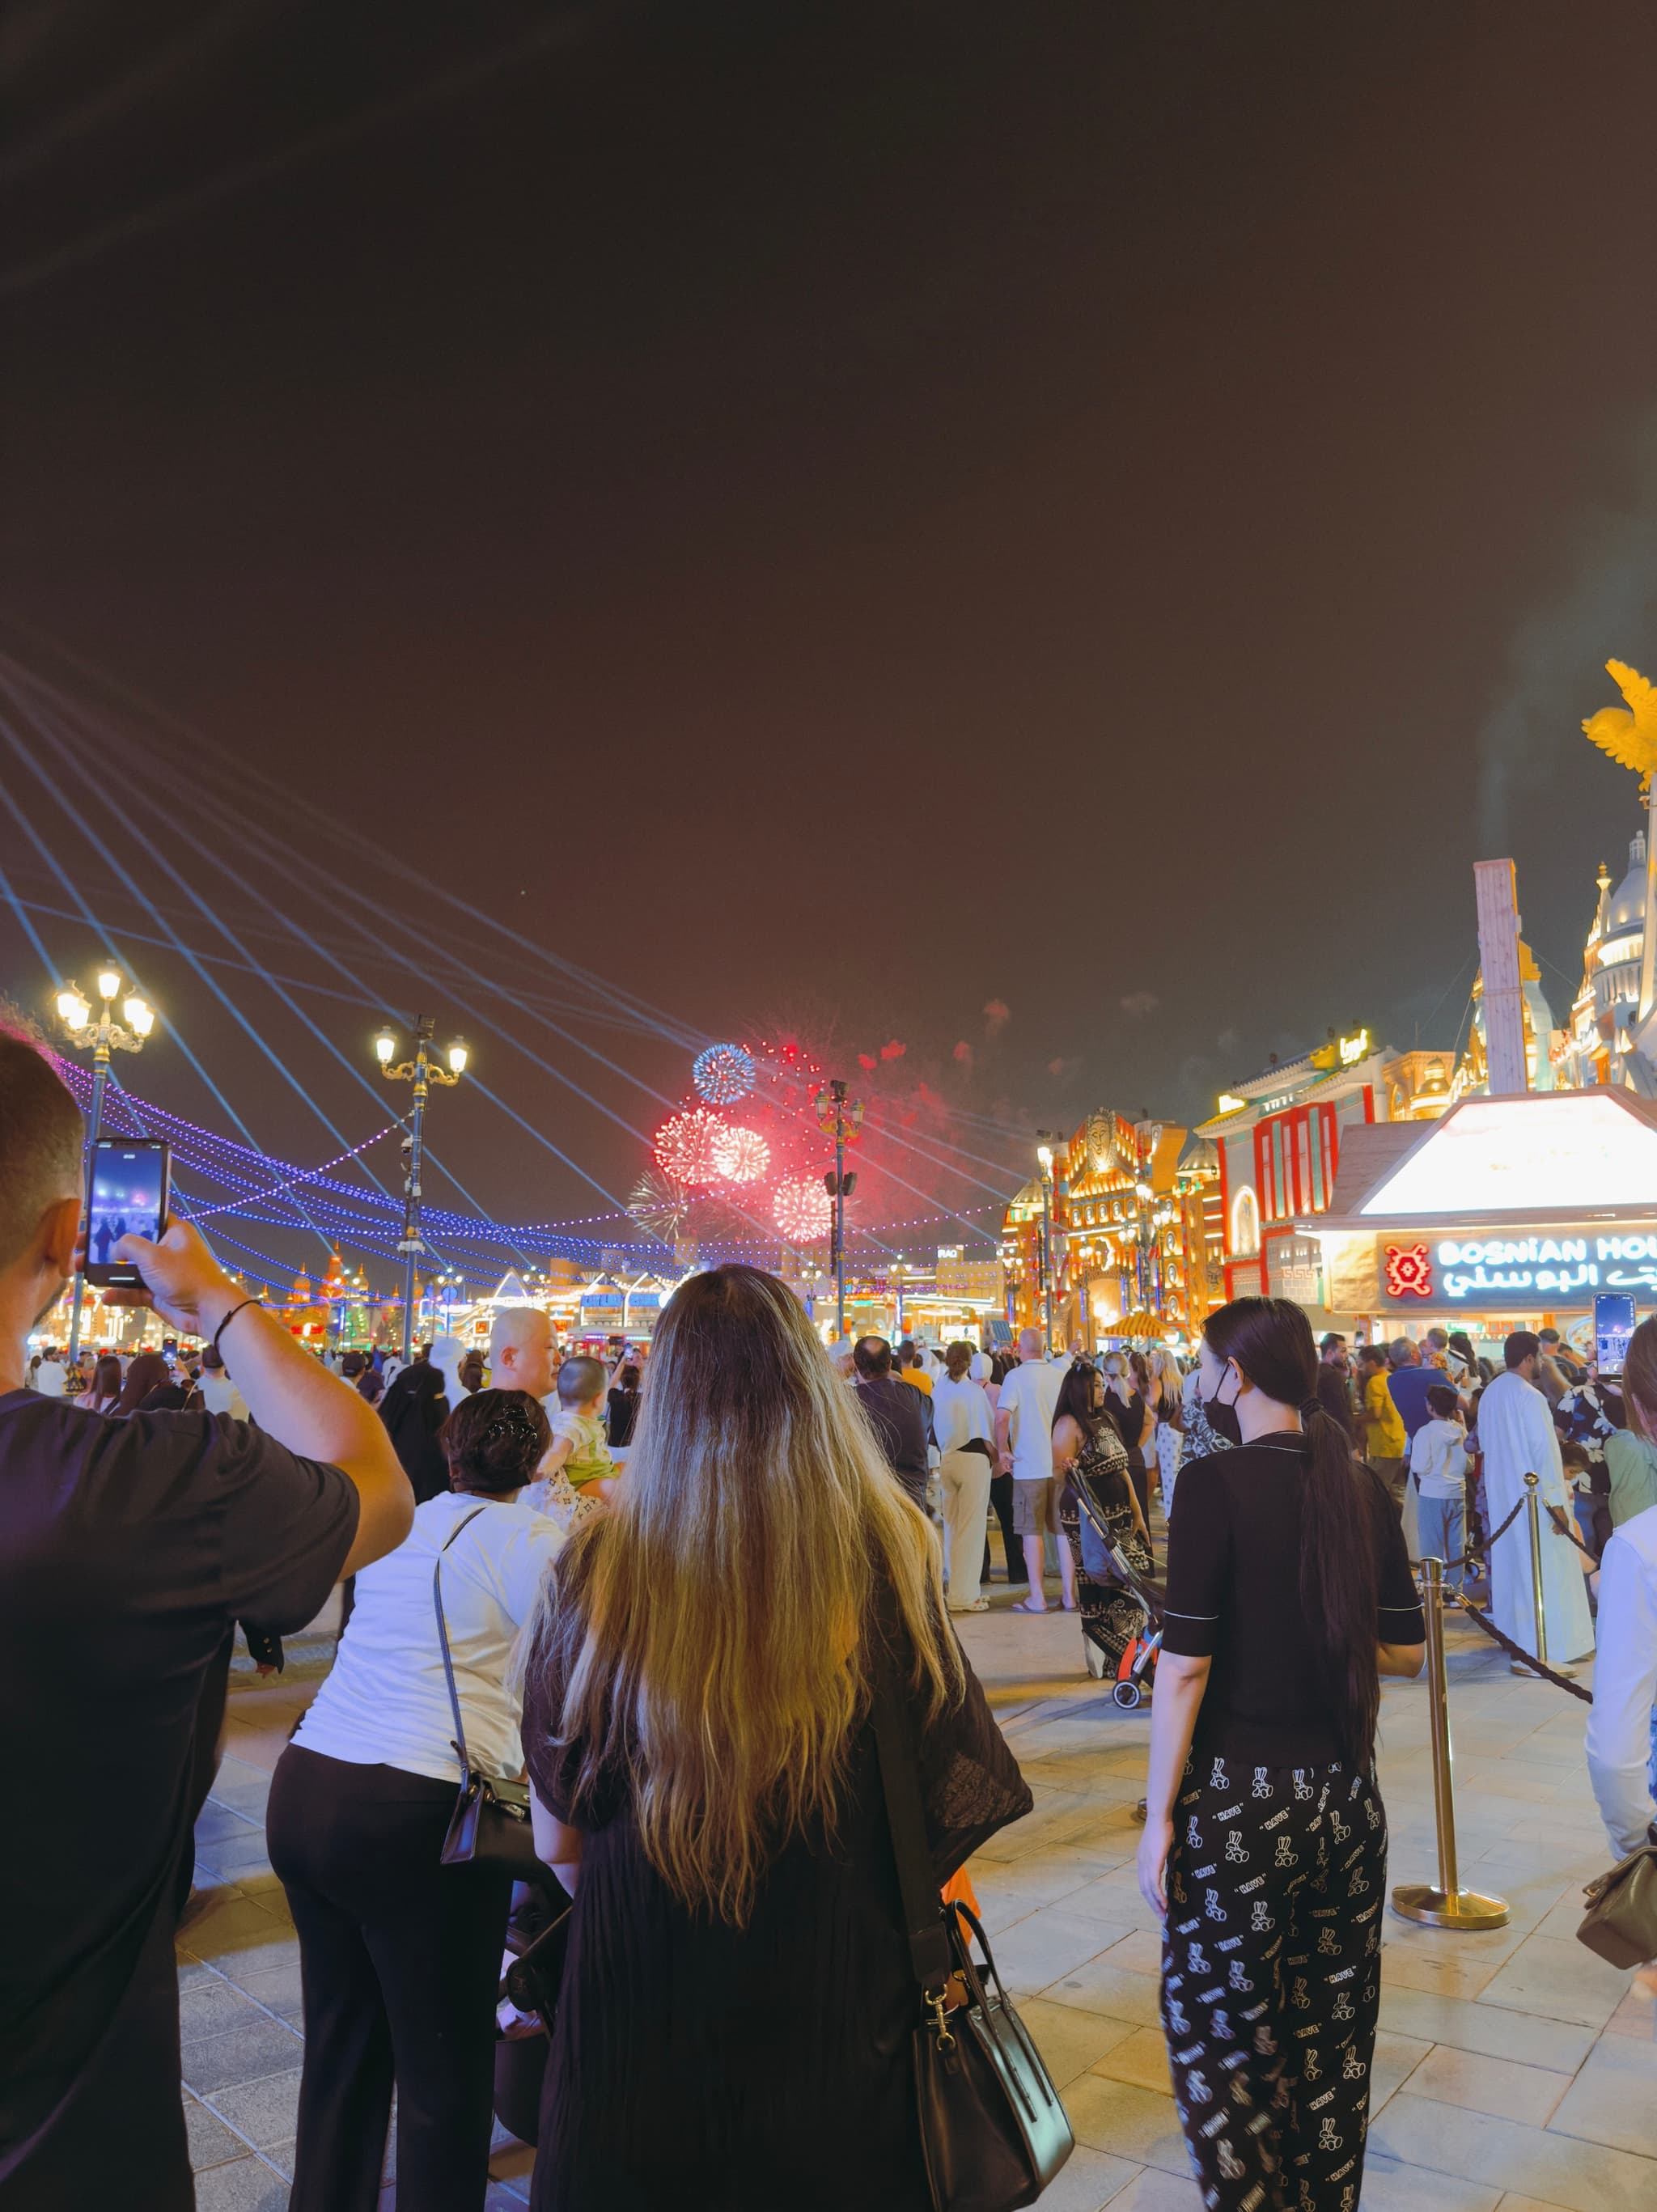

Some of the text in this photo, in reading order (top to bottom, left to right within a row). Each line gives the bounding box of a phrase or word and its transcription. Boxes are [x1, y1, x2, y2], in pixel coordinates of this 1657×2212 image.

[1259, 1807, 1291, 1830] "HAVE"
[1234, 1872, 1267, 1894] "HAVE"
[1324, 1965, 1357, 1984] "HAVE"
[1307, 2087, 1337, 2111] "HAVE"
